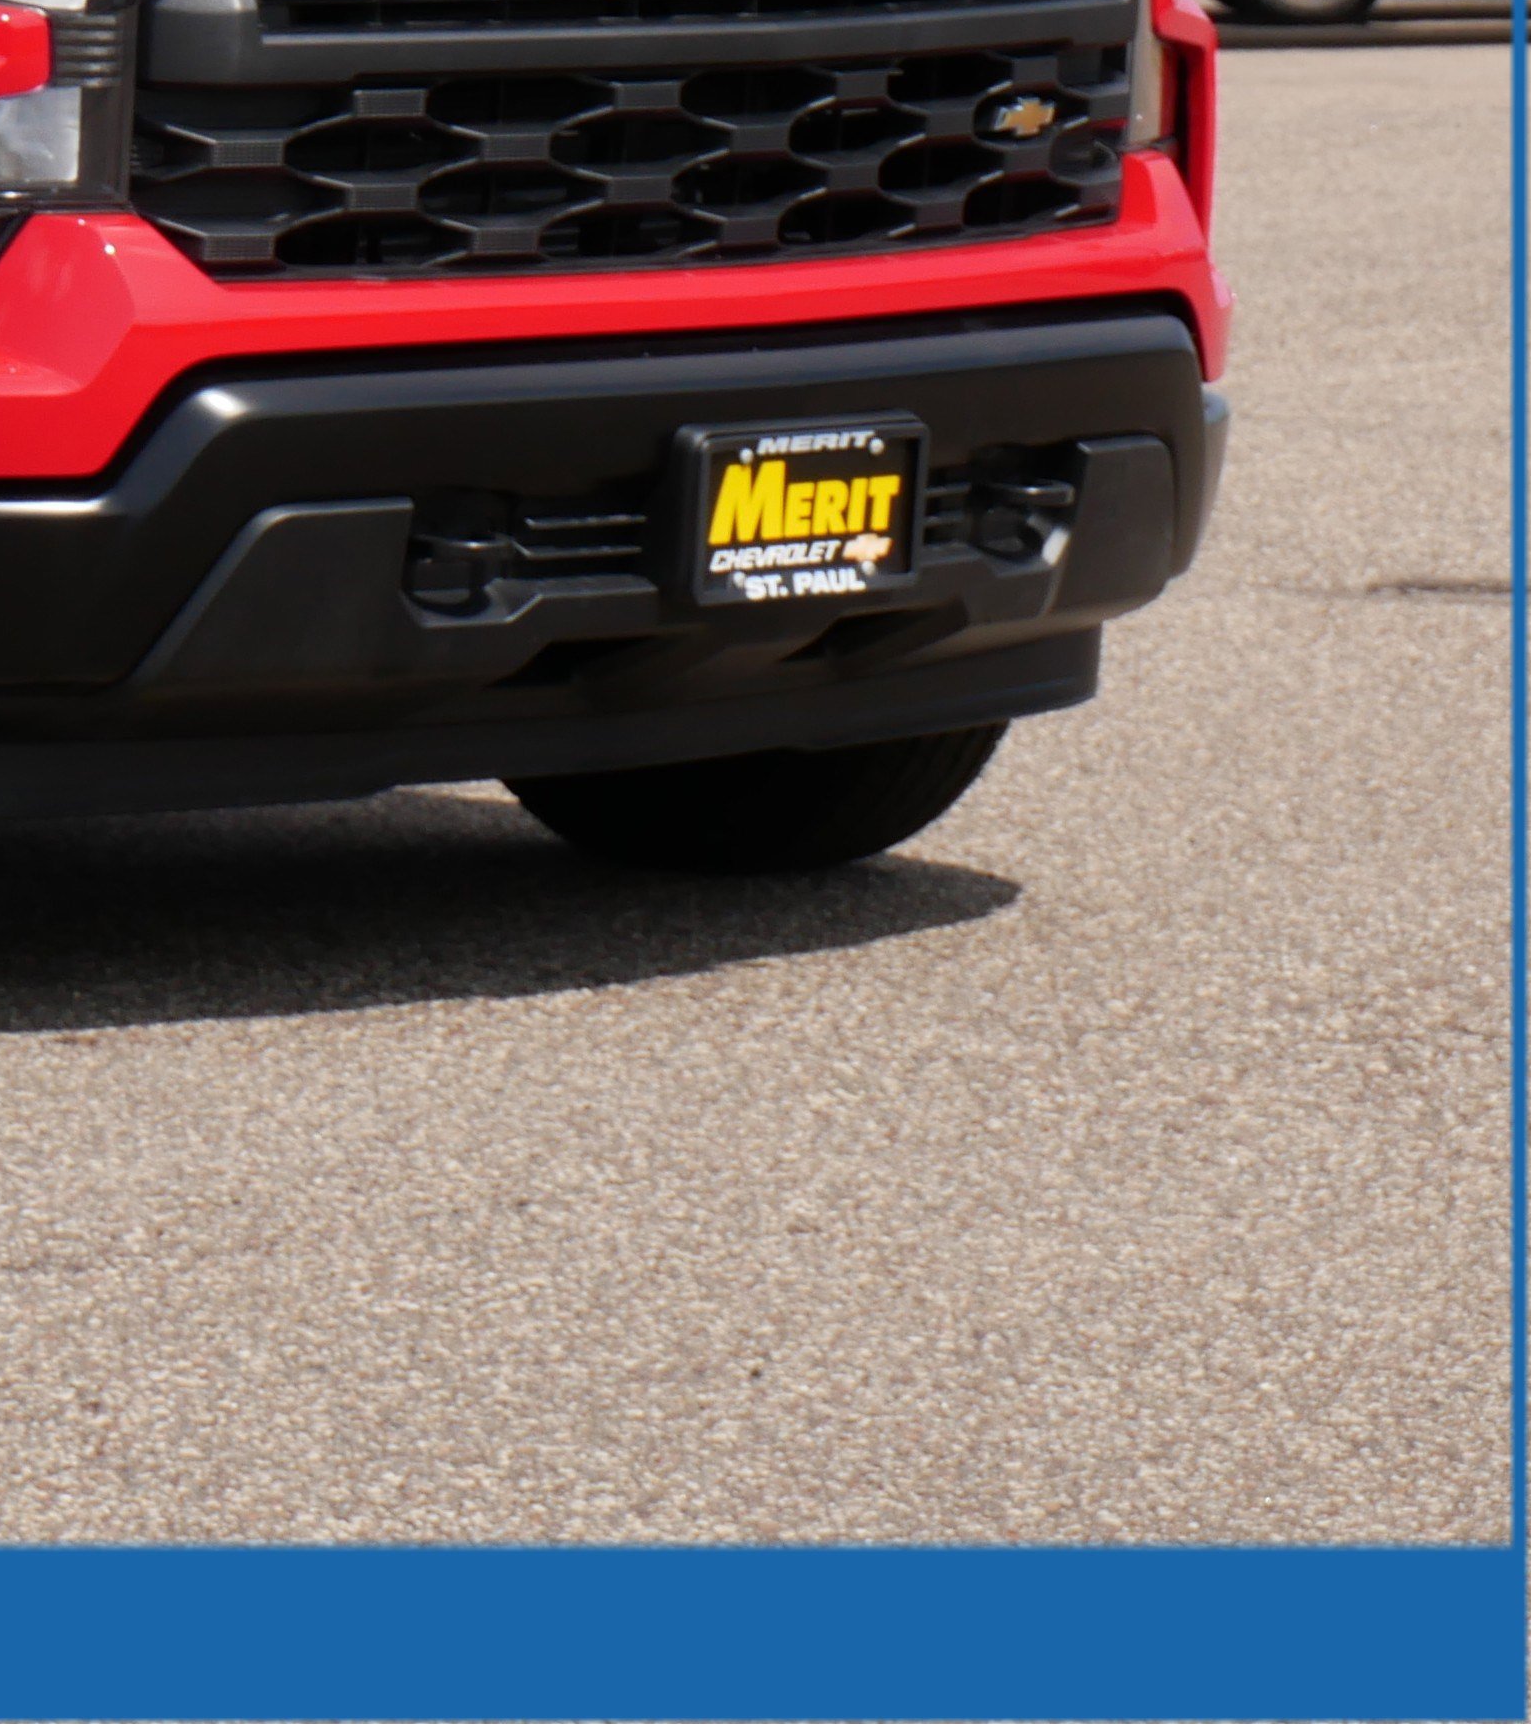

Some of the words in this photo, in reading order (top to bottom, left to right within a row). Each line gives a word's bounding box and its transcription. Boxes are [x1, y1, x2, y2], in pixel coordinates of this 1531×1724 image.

[756, 429, 876, 456] MERIT
[708, 459, 900, 545] MERIT
[709, 539, 841, 573] CHEVROLET
[744, 575, 788, 601] ST.
[792, 567, 866, 595] PAUL
